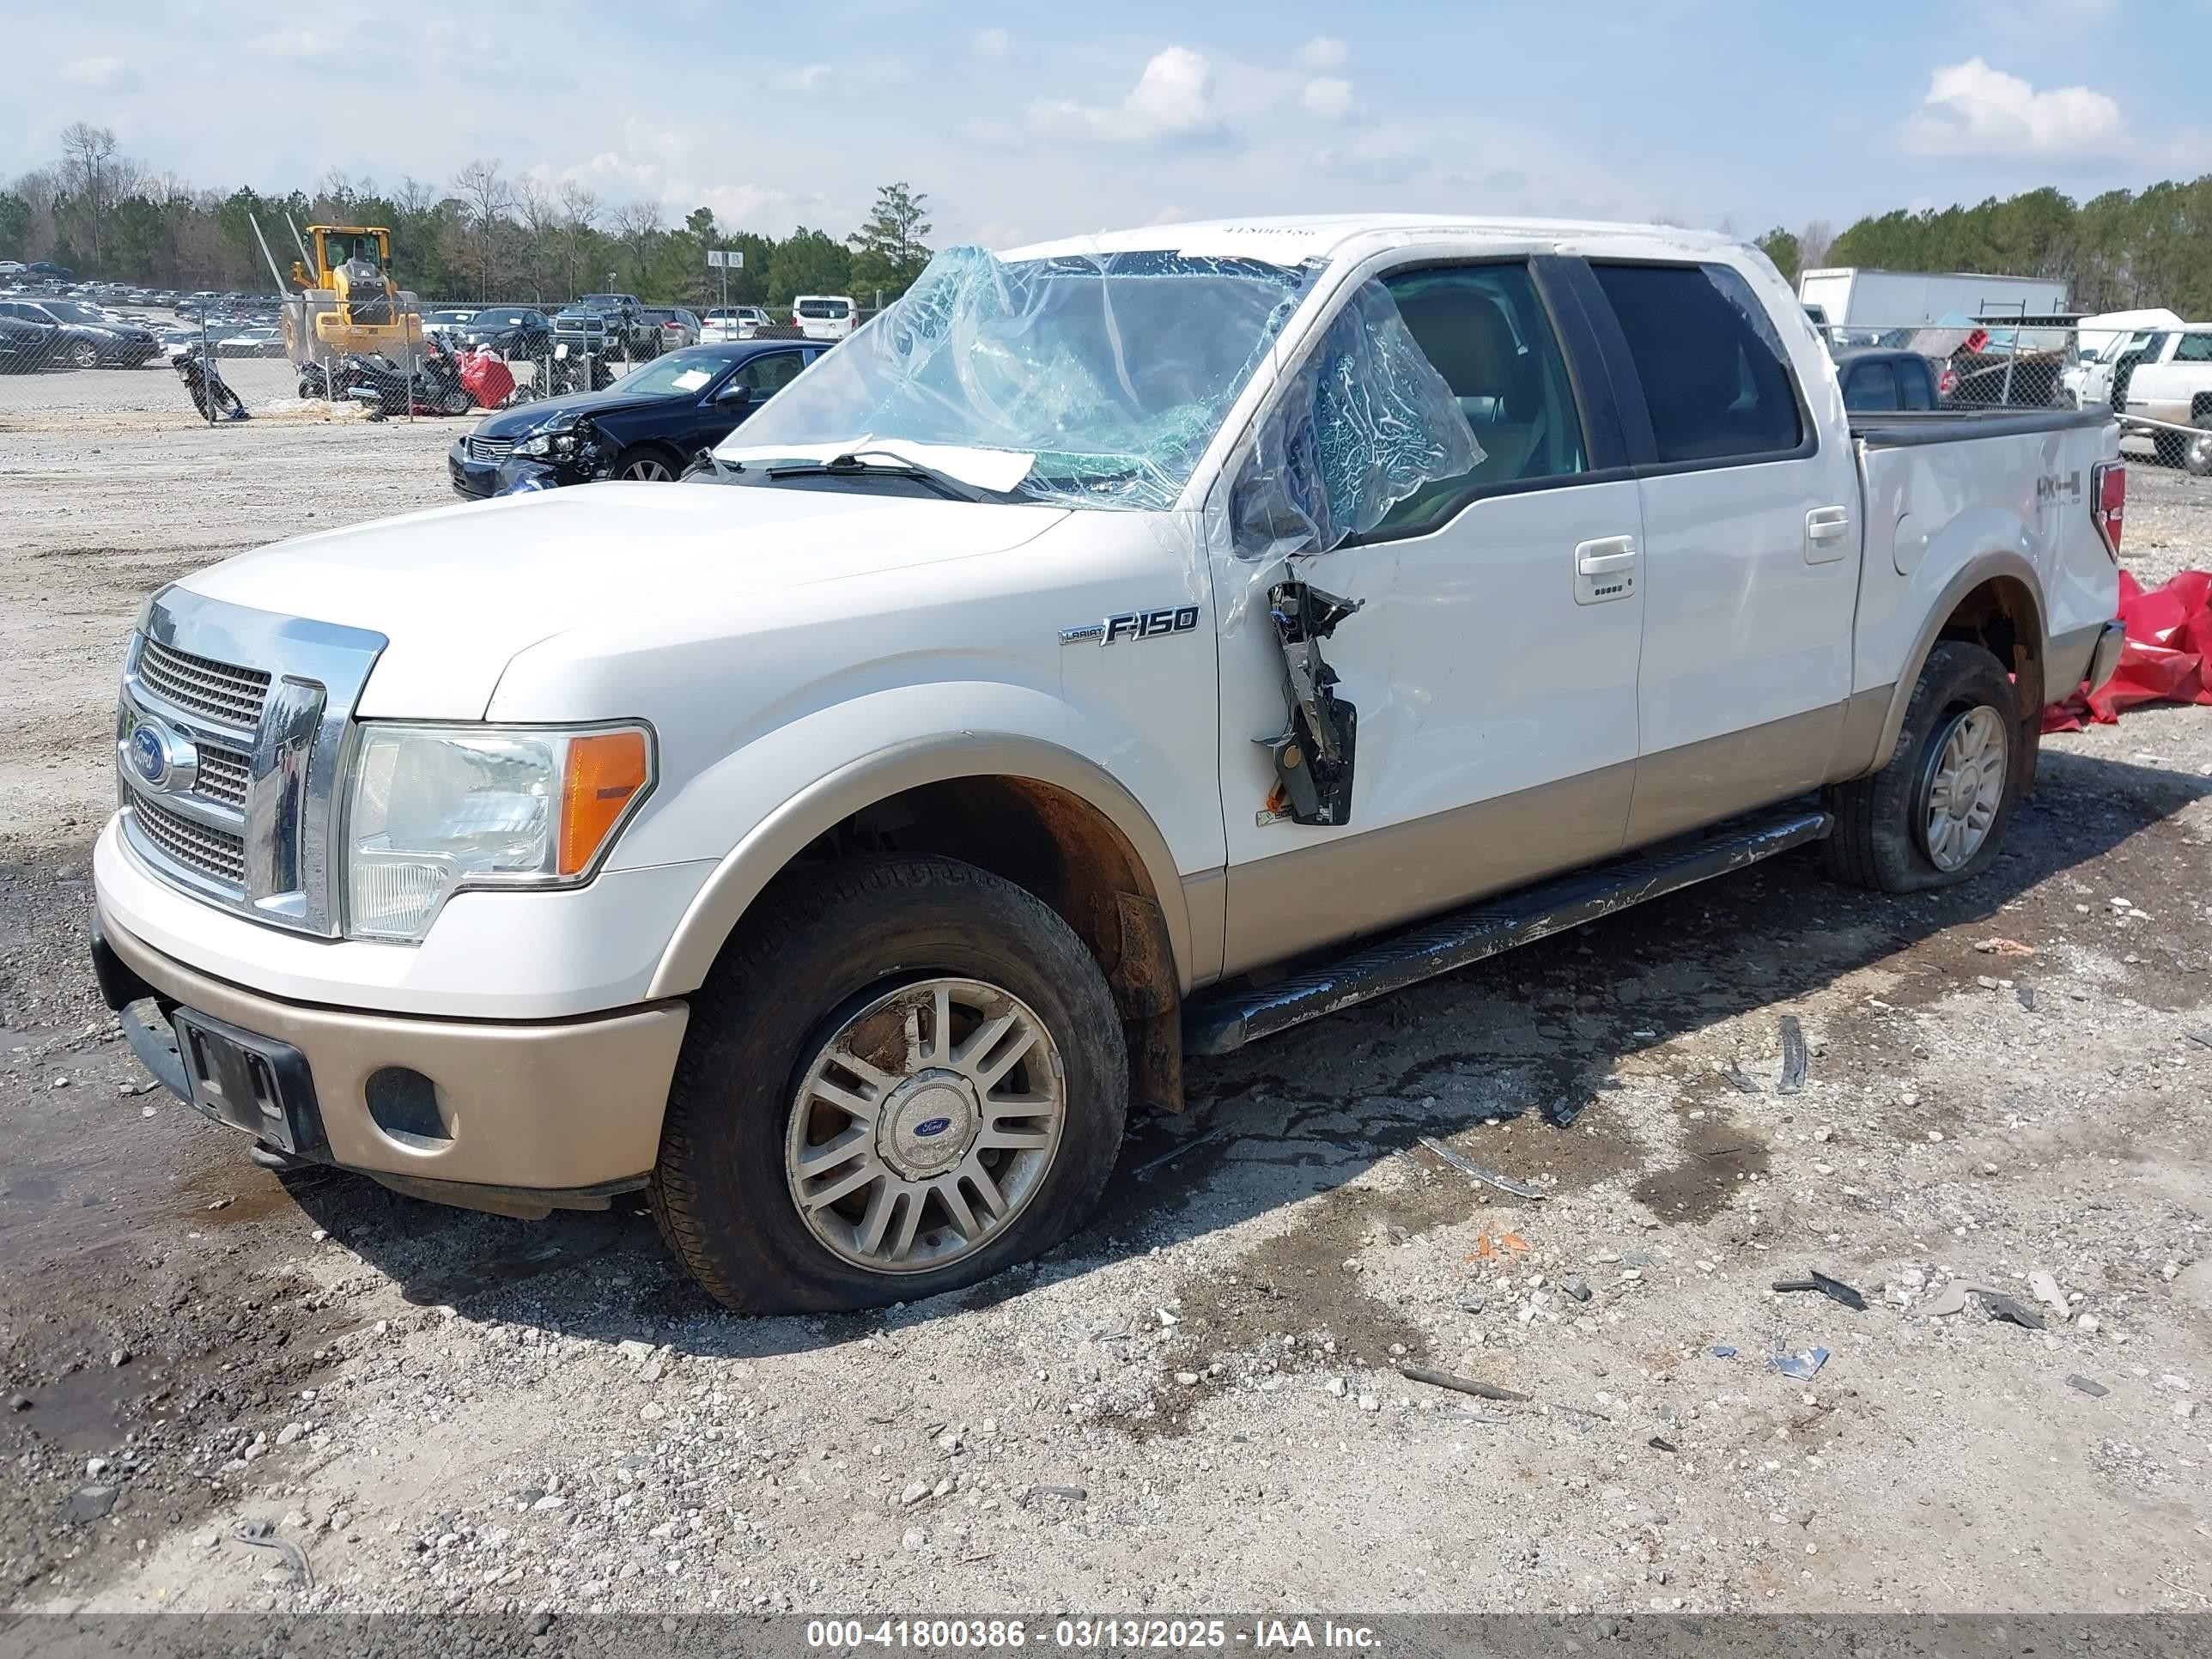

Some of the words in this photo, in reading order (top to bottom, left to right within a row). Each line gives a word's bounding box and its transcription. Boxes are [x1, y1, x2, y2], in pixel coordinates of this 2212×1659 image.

[710, 252, 721, 265] A
[732, 253, 741, 266] B
[1066, 628, 1103, 641] LARIAT
[1104, 605, 1200, 644] F-150
